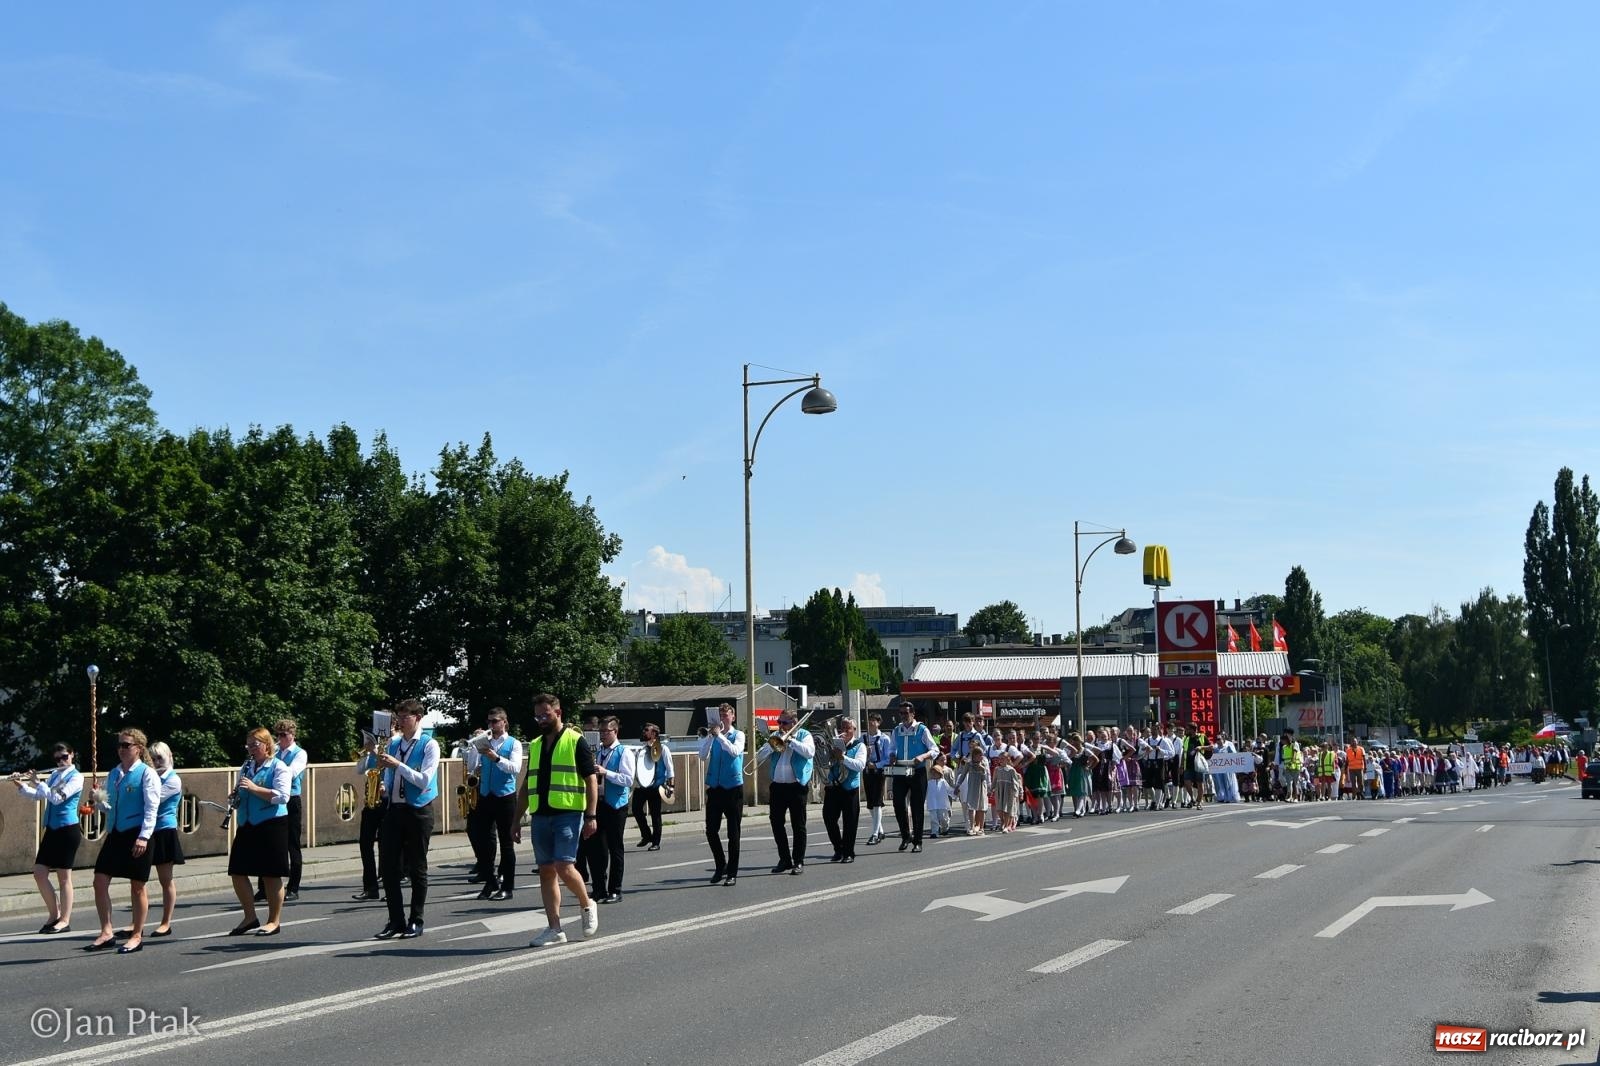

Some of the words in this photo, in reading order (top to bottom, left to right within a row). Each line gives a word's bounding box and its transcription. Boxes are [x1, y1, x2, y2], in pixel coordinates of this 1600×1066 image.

[1174, 611, 1206, 645] K
[1225, 678, 1266, 689] CIRCLE
[1191, 688, 1213, 698] 6.12
[1191, 700, 1213, 710] 5.94
[1191, 711, 1214, 722] 6.12
